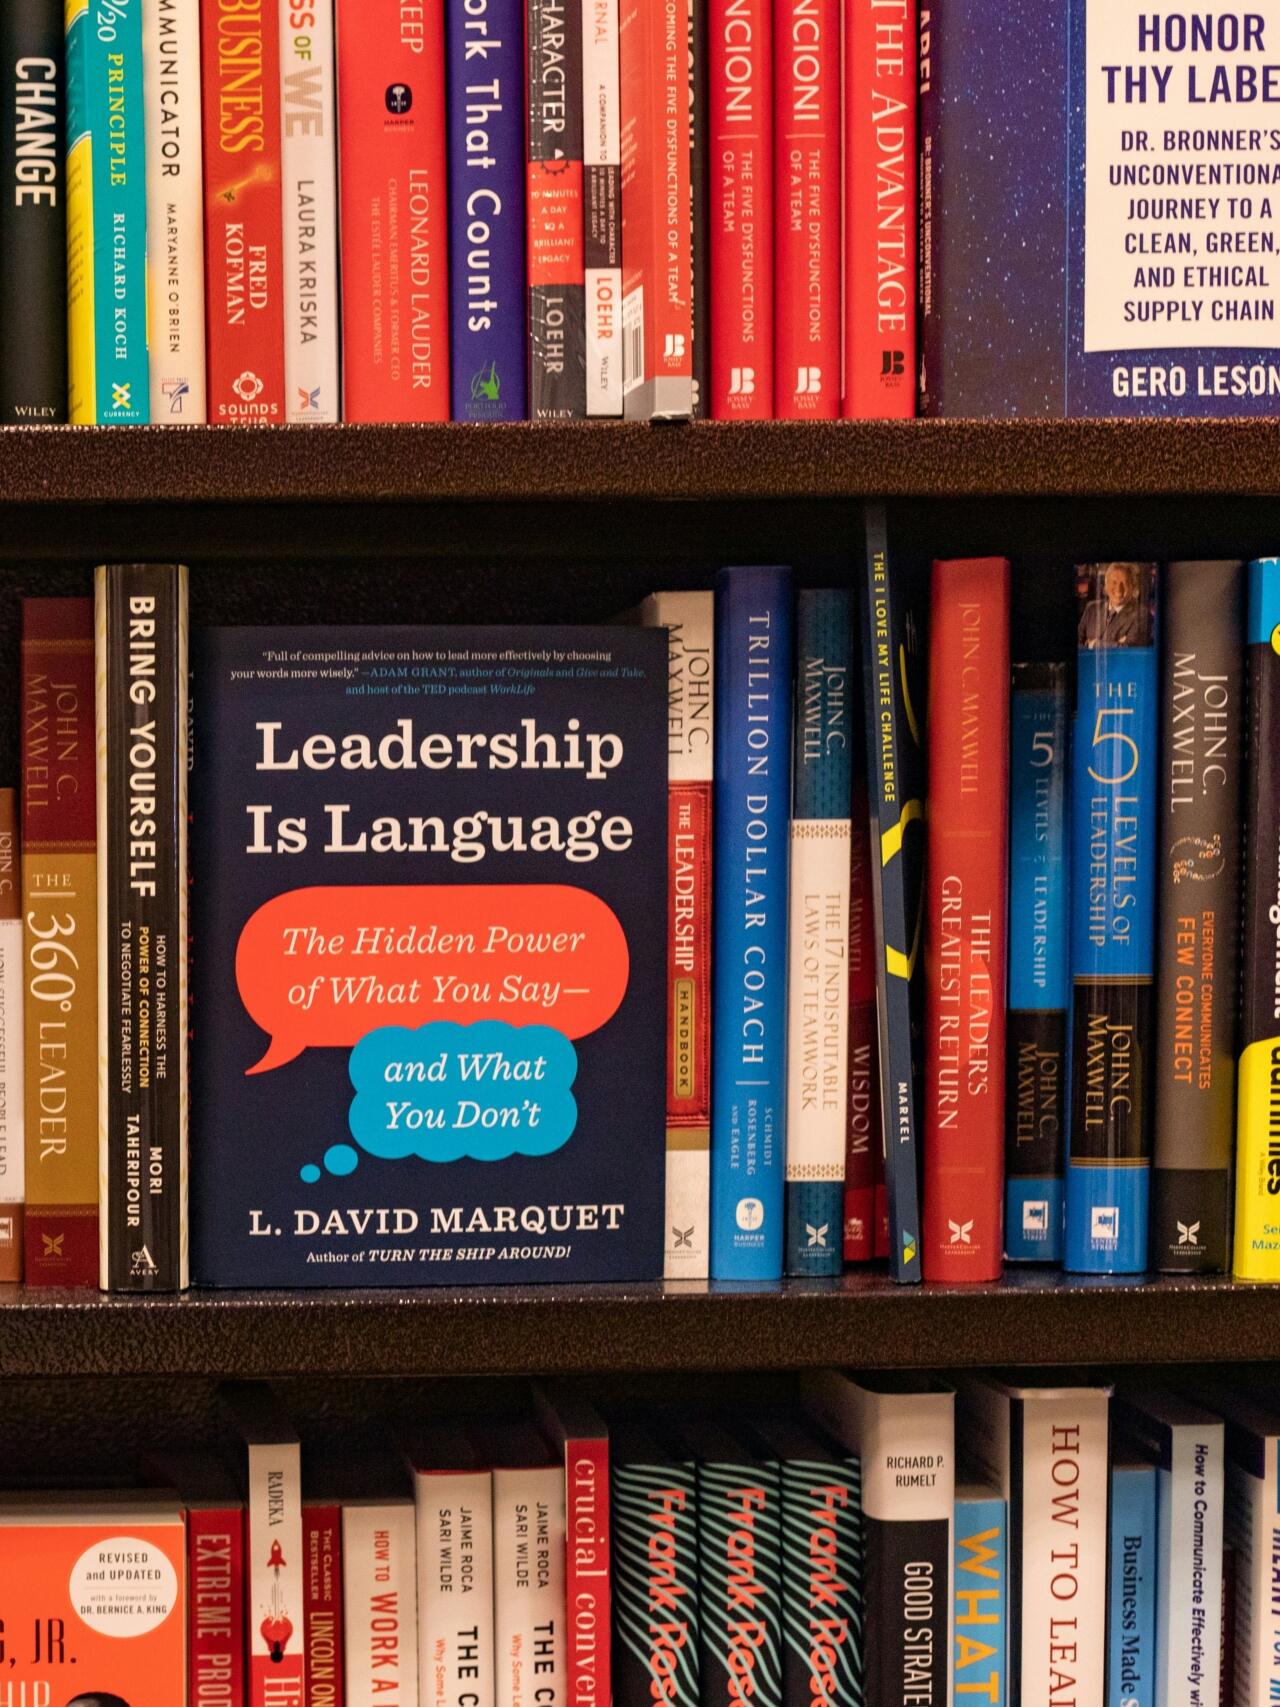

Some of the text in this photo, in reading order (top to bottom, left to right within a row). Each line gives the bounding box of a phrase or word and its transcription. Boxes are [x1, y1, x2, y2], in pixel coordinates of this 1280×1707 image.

[1139, 14, 1264, 52] HONOR
[1102, 66, 1173, 103] THY
[15, 57, 56, 206] CHANGE
[108, 53, 127, 186] PRINCIPLE
[466, 79, 502, 331] That Counts
[872, 90, 907, 332] ADVANTAGE
[226, 224, 244, 324] KOFMAN
[298, 180, 317, 344] LAURA KRISKA
[741, 150, 754, 342] THE FIVE DYSFUNCTIONS
[114, 213, 126, 359] RICHARD KOCH
[249, 246, 267, 308] FRED
[1124, 300, 1273, 322] SUPPLY CHAIN
[1113, 363, 1186, 397] GERO
[874, 552, 885, 581] THE
[876, 599, 887, 638] LOVE
[878, 644, 888, 666] MY
[879, 673, 890, 705] LIFE
[130, 597, 156, 896] BRING YOURSELF
[256, 719, 623, 779] Leadership
[881, 711, 895, 802] CHALLENGE
[247, 805, 632, 863] Is Language
[743, 611, 769, 1063] TRILLION DOLLAR COACH
[283, 926, 585, 955] The Hidden Power
[156, 935, 166, 1078] HOW TO HARNESS THE
[288, 976, 325, 1009] of
[330, 976, 420, 1004] What
[433, 976, 491, 1002] You
[385, 1053, 546, 1082] and What
[387, 1100, 541, 1129] You Don't
[898, 1082, 909, 1143] MARKEL
[127, 1114, 139, 1226] TAHERIPOUR
[150, 1147, 162, 1193] MORI
[249, 1204, 624, 1235] L. DAVID MARQUET
[268, 1472, 283, 1526] RADEKA
[896, 1474, 936, 1486] RUMELT
[575, 1458, 608, 1580] crucial
[86, 1570, 161, 1580] and UPDATED
[99, 1553, 147, 1563] REVISED
[460, 1507, 473, 1592] JAIME ROCA
[197, 1535, 231, 1639] EXTREME
[904, 1562, 933, 1620] GOOD
[30, 1618, 78, 1664] JR.
